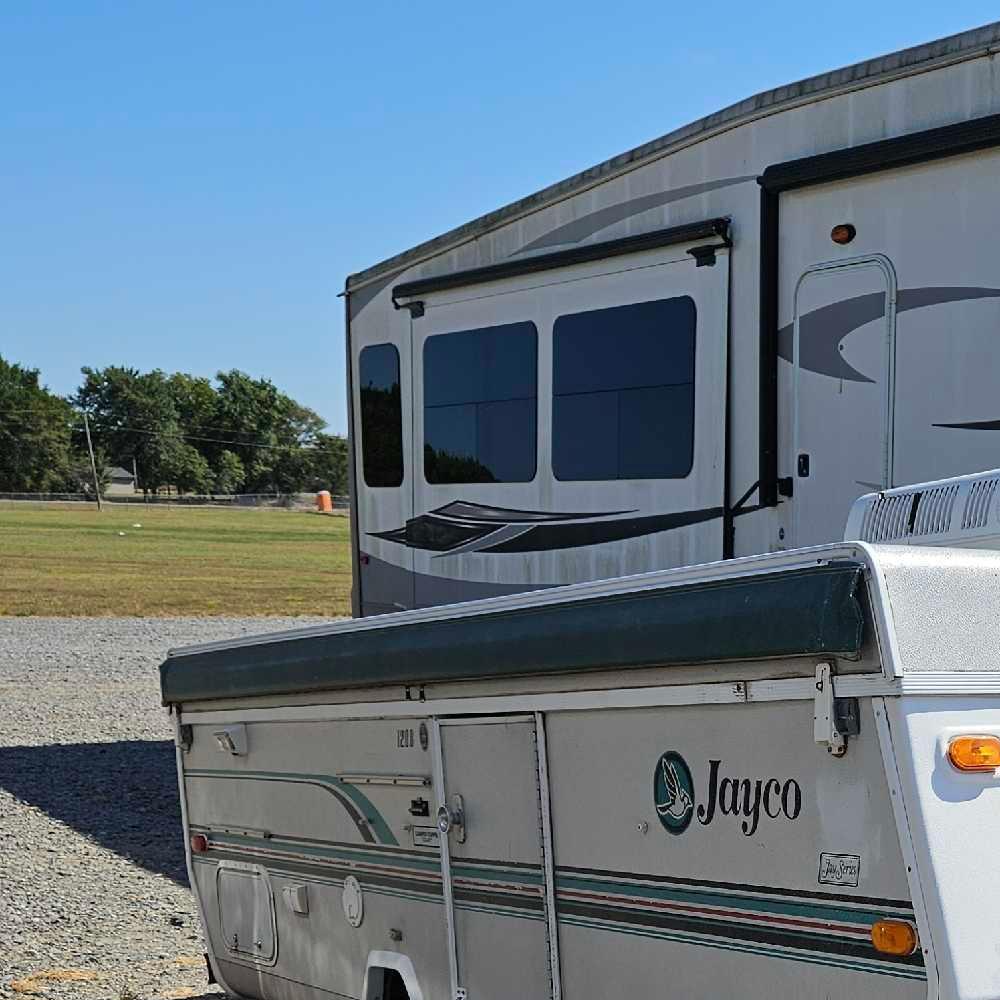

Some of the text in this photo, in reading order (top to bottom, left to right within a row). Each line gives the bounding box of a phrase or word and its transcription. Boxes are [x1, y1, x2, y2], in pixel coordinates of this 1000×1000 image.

[697, 759, 802, 836] Jayco
[822, 858, 857, 880] Jay Series
